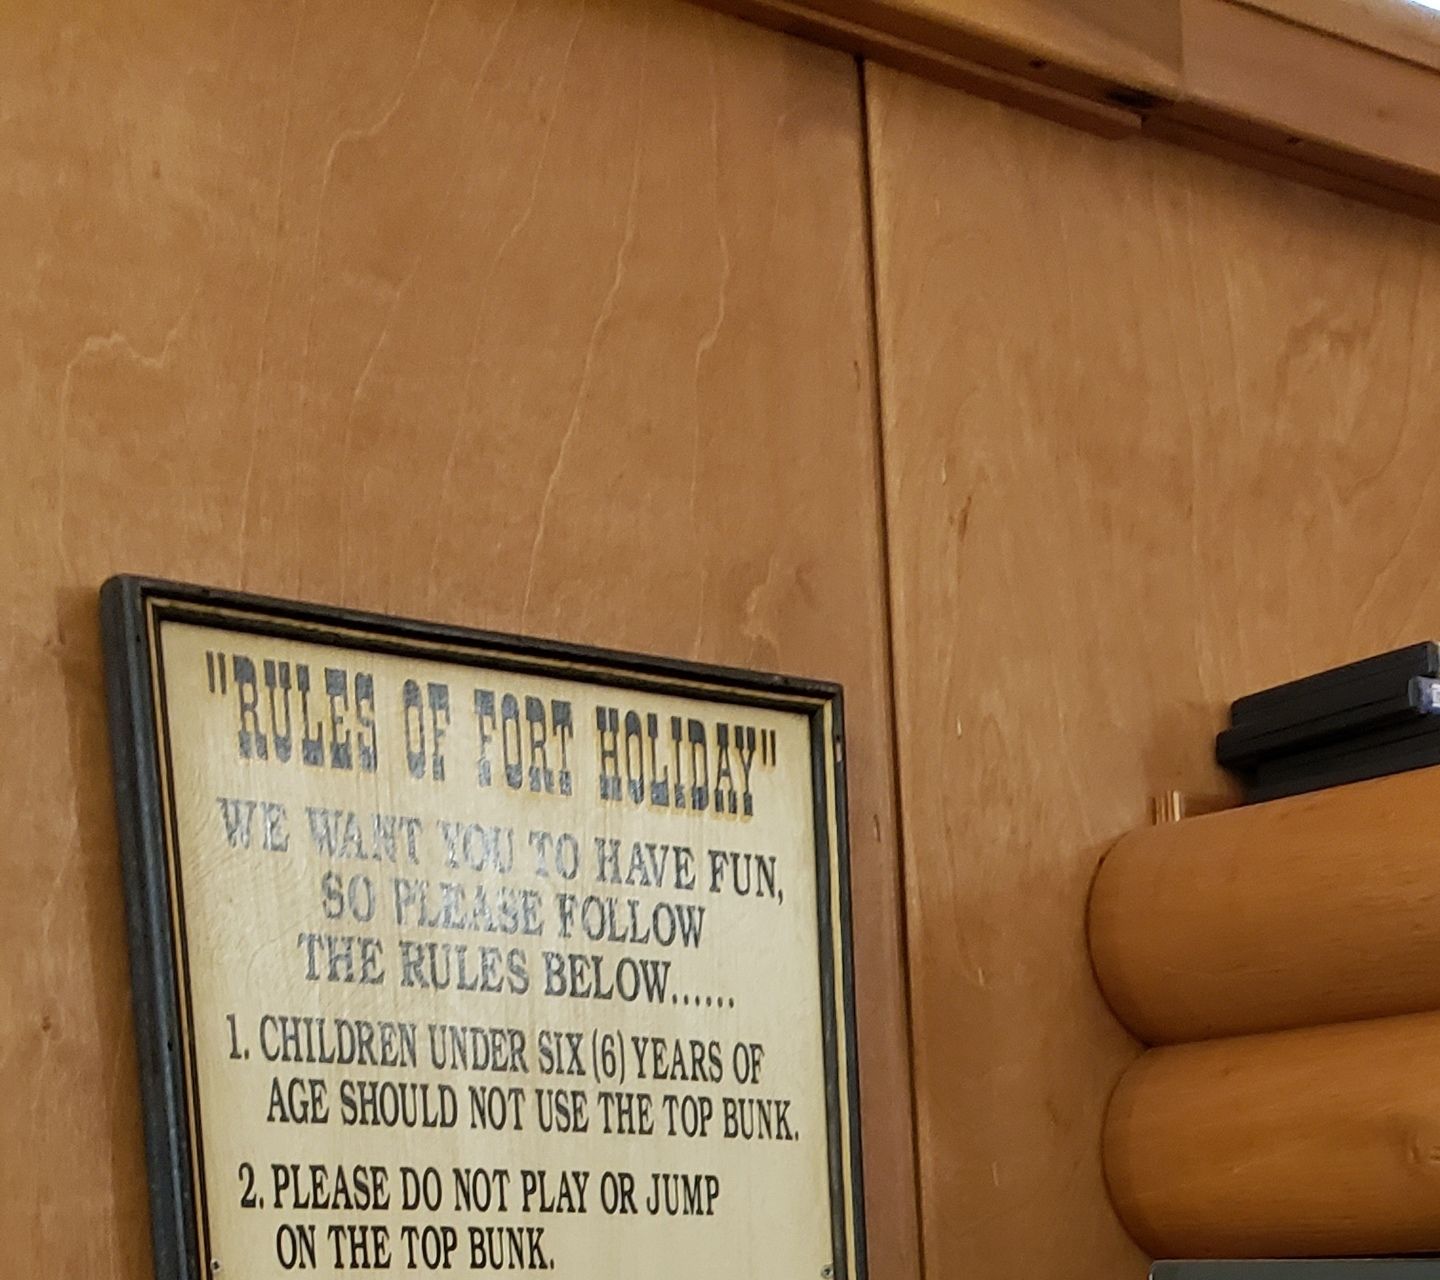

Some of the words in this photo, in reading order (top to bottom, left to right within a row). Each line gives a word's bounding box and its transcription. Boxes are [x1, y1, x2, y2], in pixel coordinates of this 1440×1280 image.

[403, 680, 450, 782] OF
[474, 690, 573, 796] FORT
[217, 797, 288, 852] WE
[306, 807, 422, 864] WANT
[439, 821, 514, 875] YOU
[529, 831, 581, 882] TO
[595, 837, 696, 890] HAVE
[708, 849, 785, 905] FUN,
[322, 873, 376, 922] SO
[394, 878, 544, 937] PLEASE
[559, 895, 705, 948] FOLLOW
[299, 933, 385, 985] THE
[400, 941, 528, 995] RULES
[226, 1014, 249, 1060] 1.
[260, 1014, 416, 1067] CHILDREN
[428, 1024, 529, 1073] UNDER
[538, 1030, 586, 1076] SIX
[592, 1029, 625, 1084] (6)
[631, 1036, 723, 1083] YEARS
[733, 1042, 765, 1084] OF
[267, 1077, 329, 1124] AGE
[340, 1080, 457, 1128] SHOULD
[469, 1086, 525, 1131] NOT
[535, 1089, 589, 1133] USE
[598, 1092, 654, 1135] THE
[663, 1095, 712, 1138] TOP
[722, 1097, 799, 1141] BUNK.
[238, 1162, 264, 1209] 2.
[271, 1164, 390, 1210] PLEASE
[400, 1167, 442, 1211] DO
[452, 1168, 510, 1212] NOT
[520, 1170, 589, 1213] PLAY
[601, 1171, 638, 1215] OR
[647, 1173, 719, 1216] JUMP
[276, 1224, 316, 1270] ON
[328, 1225, 391, 1269] THE
[401, 1225, 457, 1270] TOP
[468, 1227, 554, 1270] BUNK.
